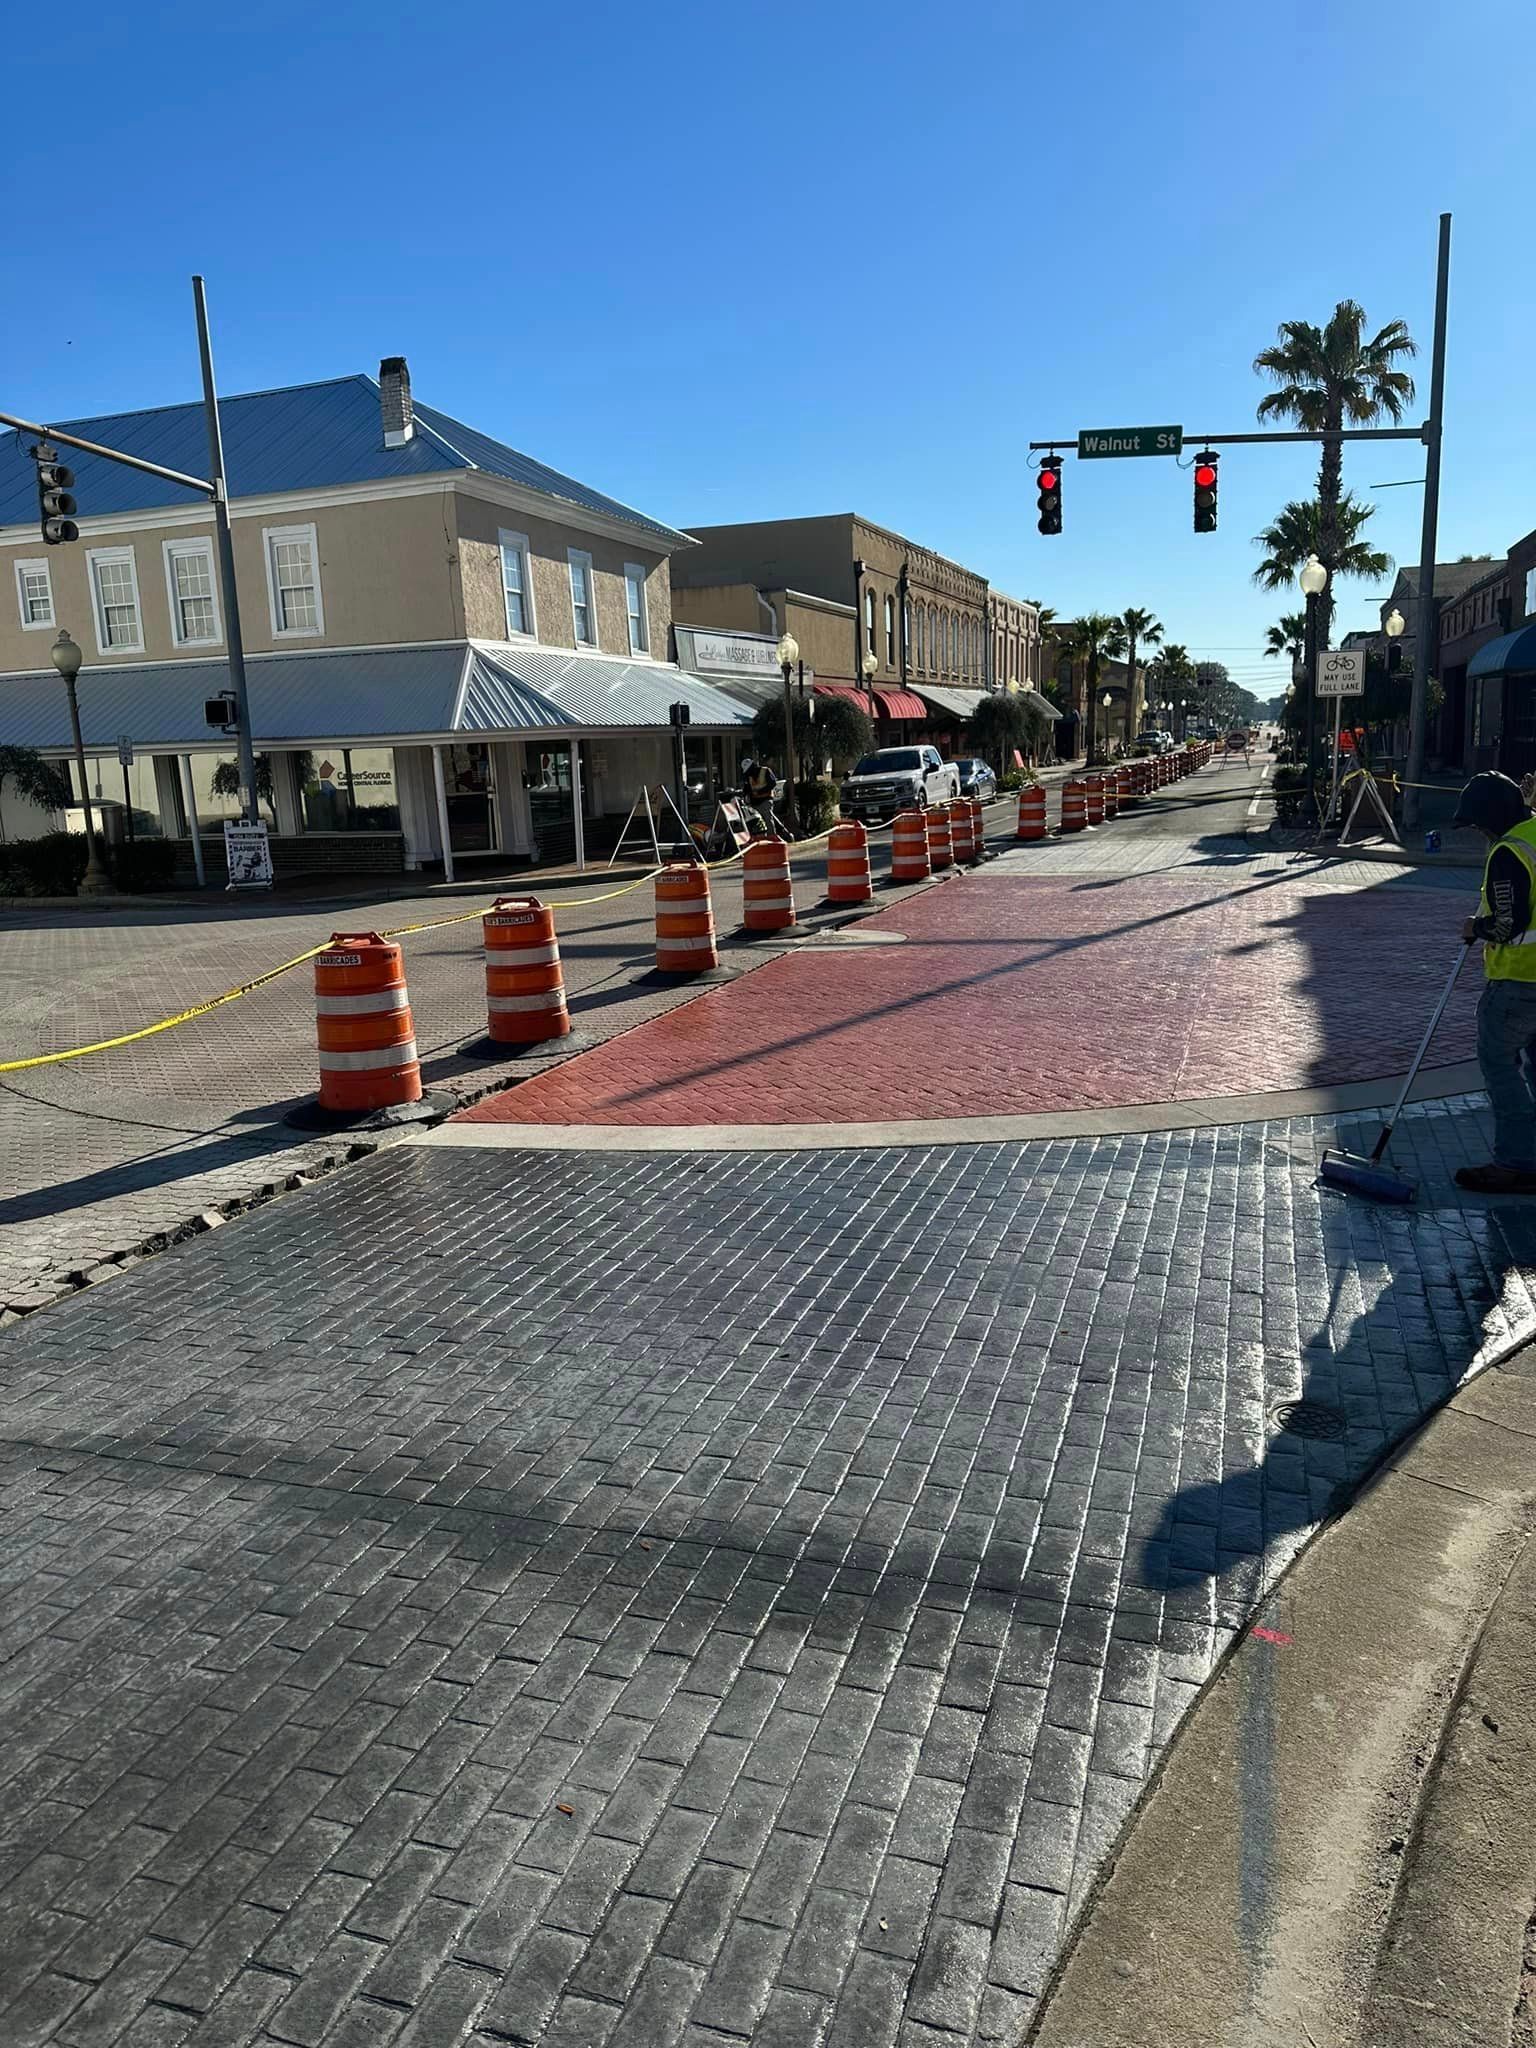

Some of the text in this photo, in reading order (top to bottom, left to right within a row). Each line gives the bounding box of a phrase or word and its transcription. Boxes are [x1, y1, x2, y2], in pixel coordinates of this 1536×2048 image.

[1084, 432, 1176, 452] Walnut St
[725, 646, 752, 662] MASSAGE
[1324, 673, 1356, 681] MAY USE
[1320, 682, 1360, 691] FULL LANE
[337, 771, 391, 780] CaeerSource
[320, 955, 359, 965] BARRICADES
